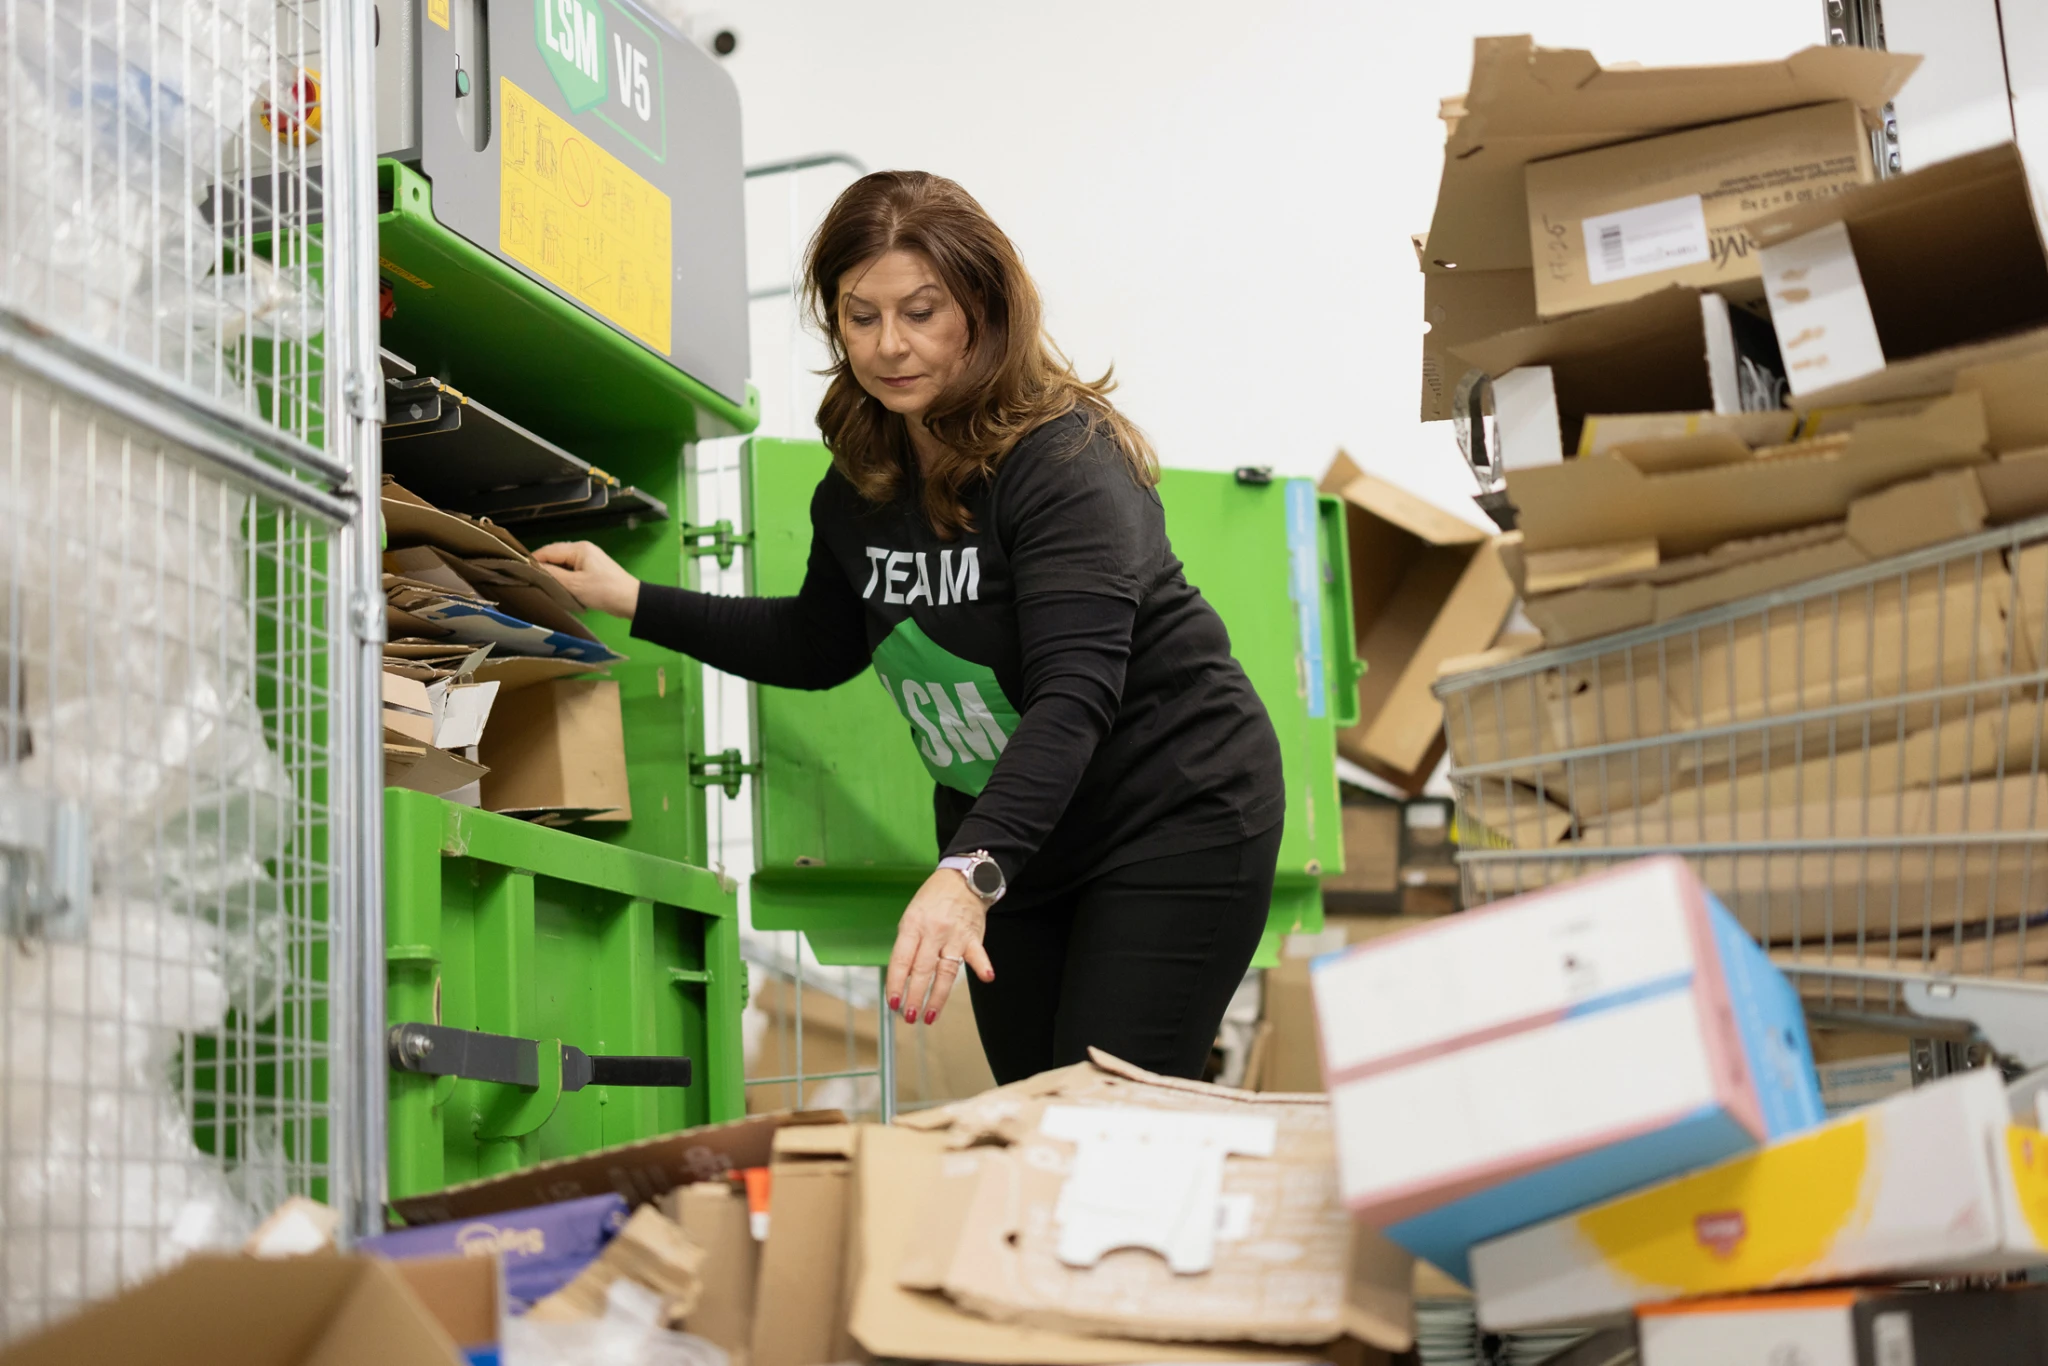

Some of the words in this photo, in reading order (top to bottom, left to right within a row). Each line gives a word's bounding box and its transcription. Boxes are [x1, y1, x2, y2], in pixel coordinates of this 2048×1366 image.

[544, 0, 599, 84] LSM
[613, 32, 651, 122] V5
[862, 546, 981, 606] TEAM
